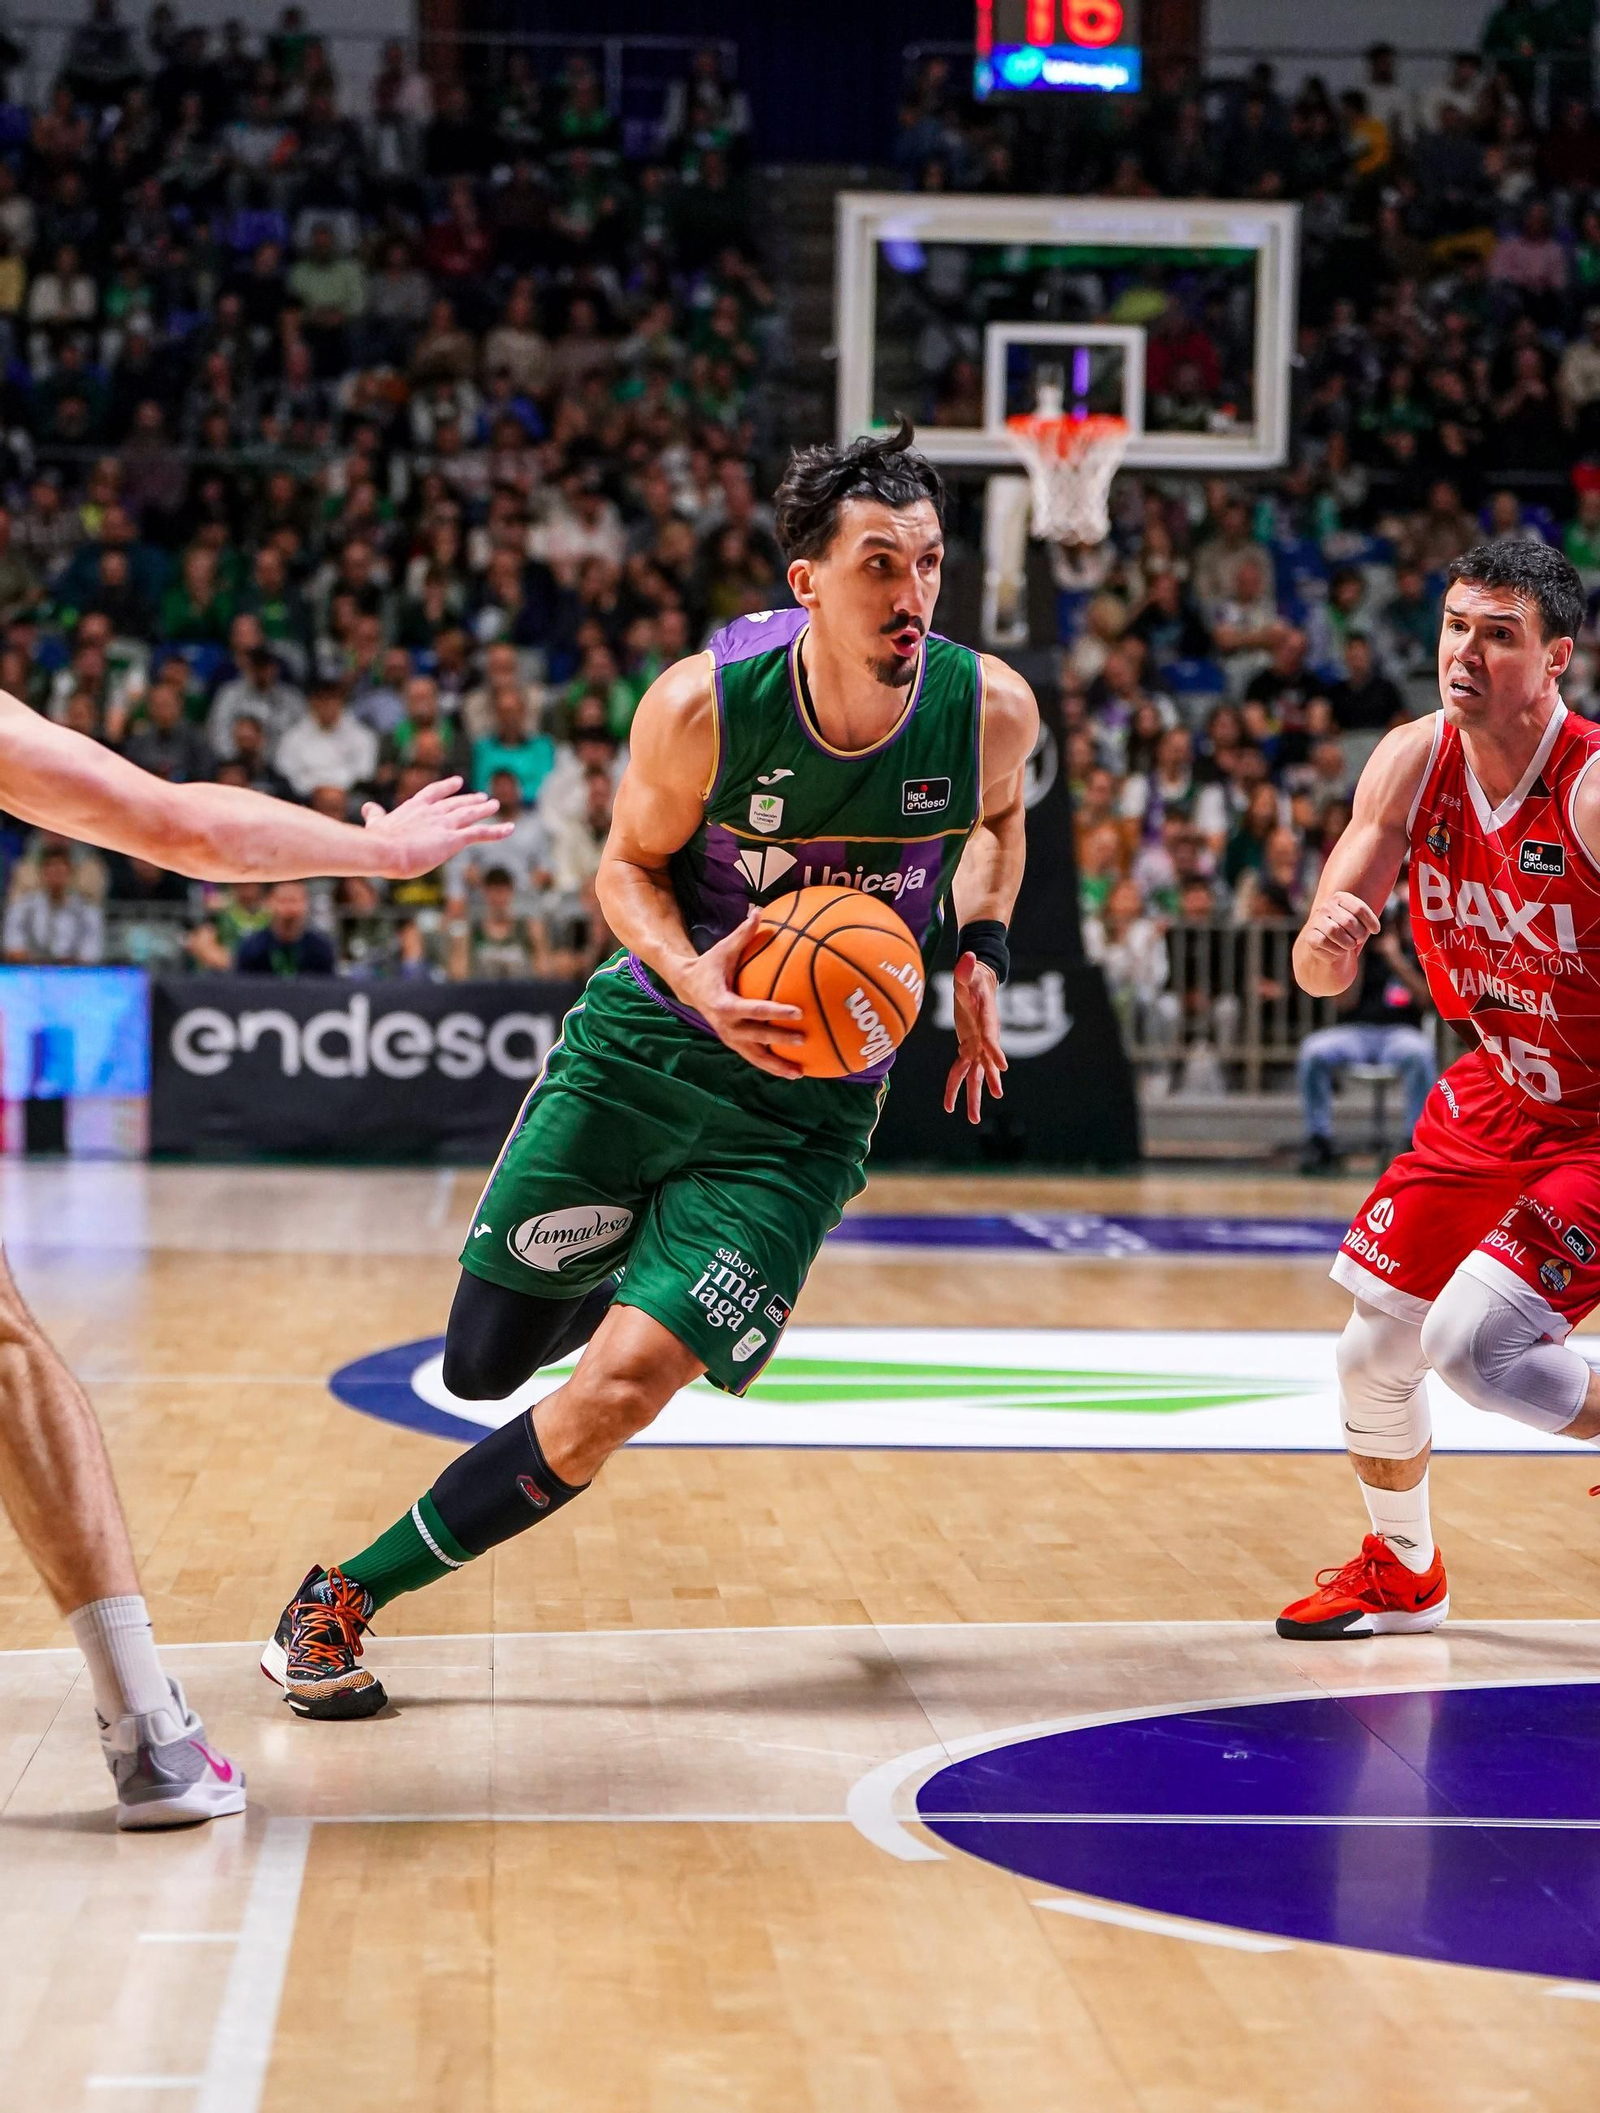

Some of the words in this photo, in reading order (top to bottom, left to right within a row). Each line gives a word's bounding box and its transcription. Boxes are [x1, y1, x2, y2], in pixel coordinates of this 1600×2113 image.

[906, 799, 946, 810] endesa
[907, 791, 926, 802] liga
[1523, 850, 1541, 862] liga
[1523, 861, 1561, 872] endesa
[803, 865, 928, 901] Unicaja
[1418, 860, 1579, 954] BAXI
[1429, 927, 1584, 976] LIMAIZACIÓN
[170, 993, 557, 1080] endesa
[519, 1211, 630, 1253] famadesa
[1481, 1228, 1527, 1266] OBAL
[1566, 1235, 1585, 1257] acb
[707, 1260, 719, 1272] a
[715, 1247, 759, 1279] sabor
[688, 1271, 745, 1332] laga
[710, 1265, 768, 1313] má
[767, 1305, 784, 1322] acb
